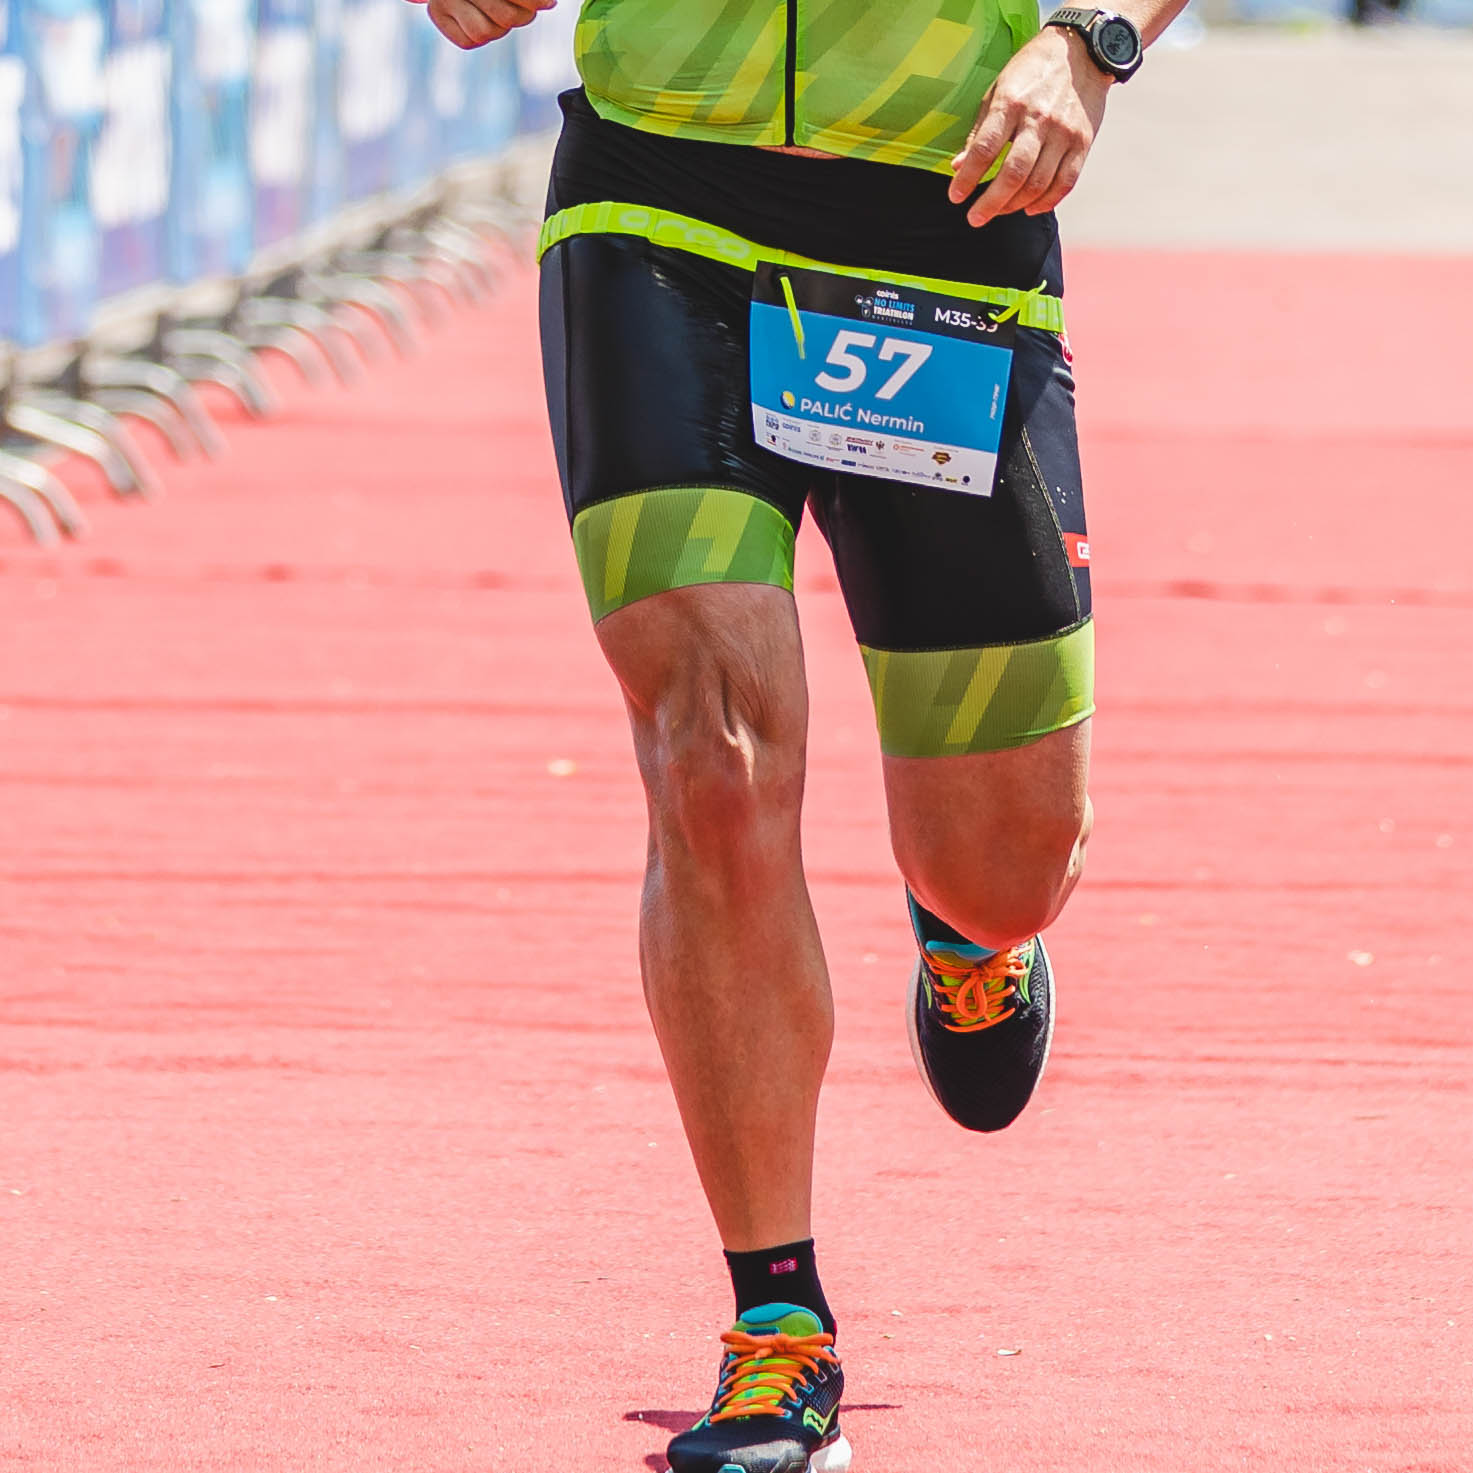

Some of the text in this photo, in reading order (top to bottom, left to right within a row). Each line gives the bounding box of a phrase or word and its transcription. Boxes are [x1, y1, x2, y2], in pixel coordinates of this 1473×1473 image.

[873, 305, 915, 321] TRIATHLON
[889, 300, 916, 313] LIMITS
[814, 329, 933, 400] 57
[800, 397, 853, 420] PALIĆ
[856, 408, 924, 433] Nermin
